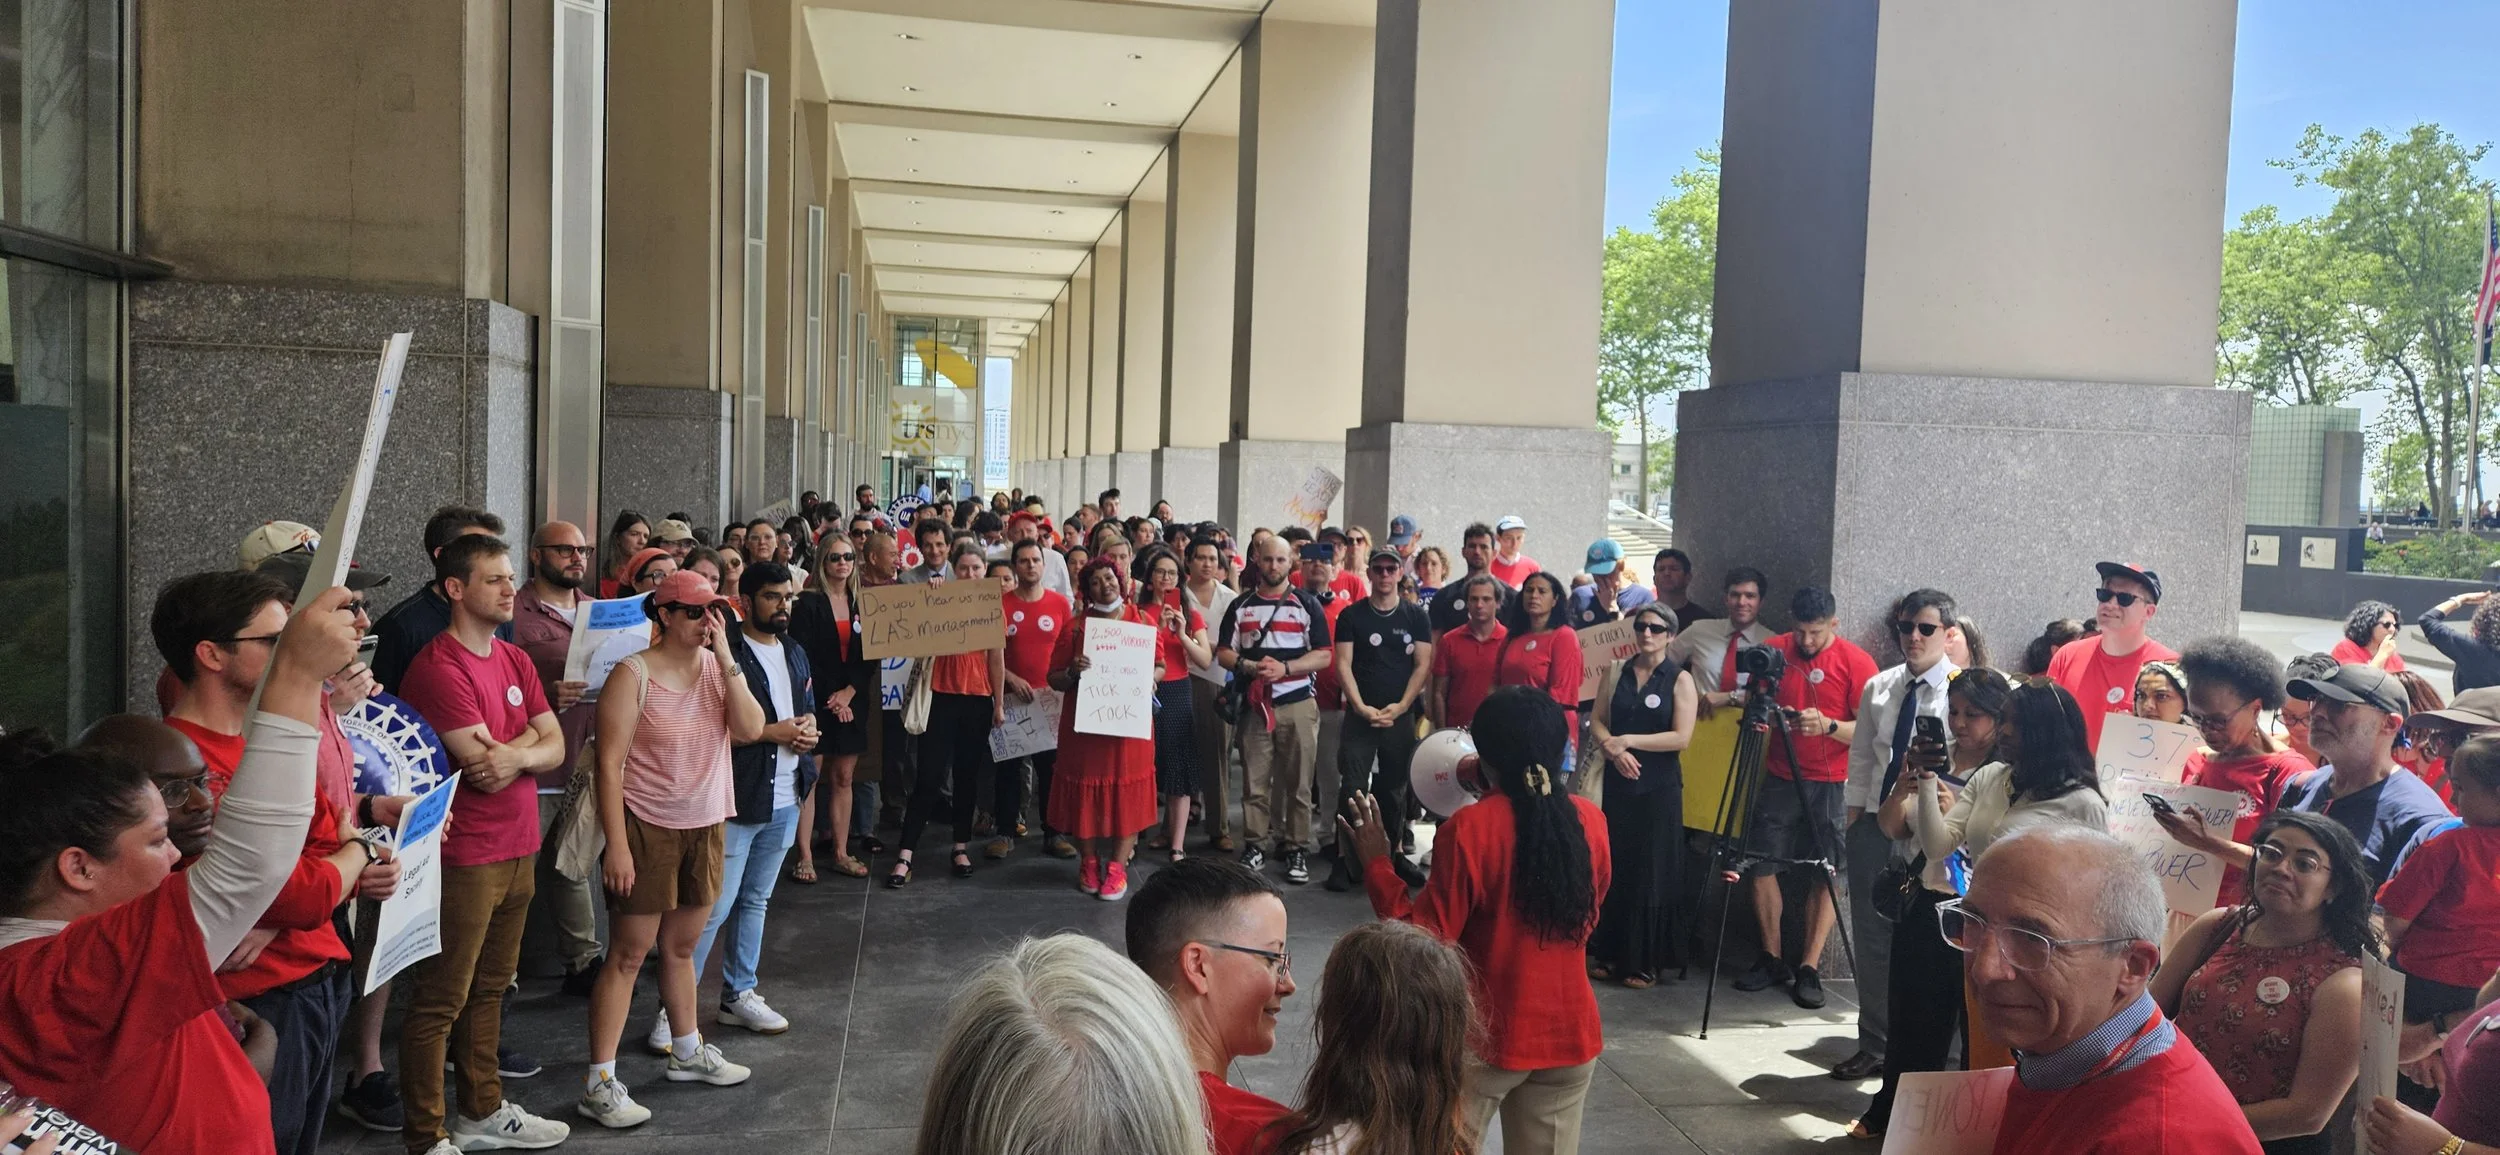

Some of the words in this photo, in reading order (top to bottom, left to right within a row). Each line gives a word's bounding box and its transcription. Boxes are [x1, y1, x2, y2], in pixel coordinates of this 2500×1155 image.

[900, 510, 911, 522] UA
[862, 592, 887, 617] Do
[893, 601, 916, 621] you
[923, 589, 955, 607] hear
[958, 595, 972, 604] us
[978, 592, 1001, 602] now
[870, 619, 913, 646] LAS
[1084, 683, 1120, 699] TICK
[1089, 704, 1138, 723] TOCK
[377, 732, 388, 740] OF
[403, 861, 422, 882] Legal
[404, 877, 424, 899] Society
[34, 1107, 118, 1155] water
